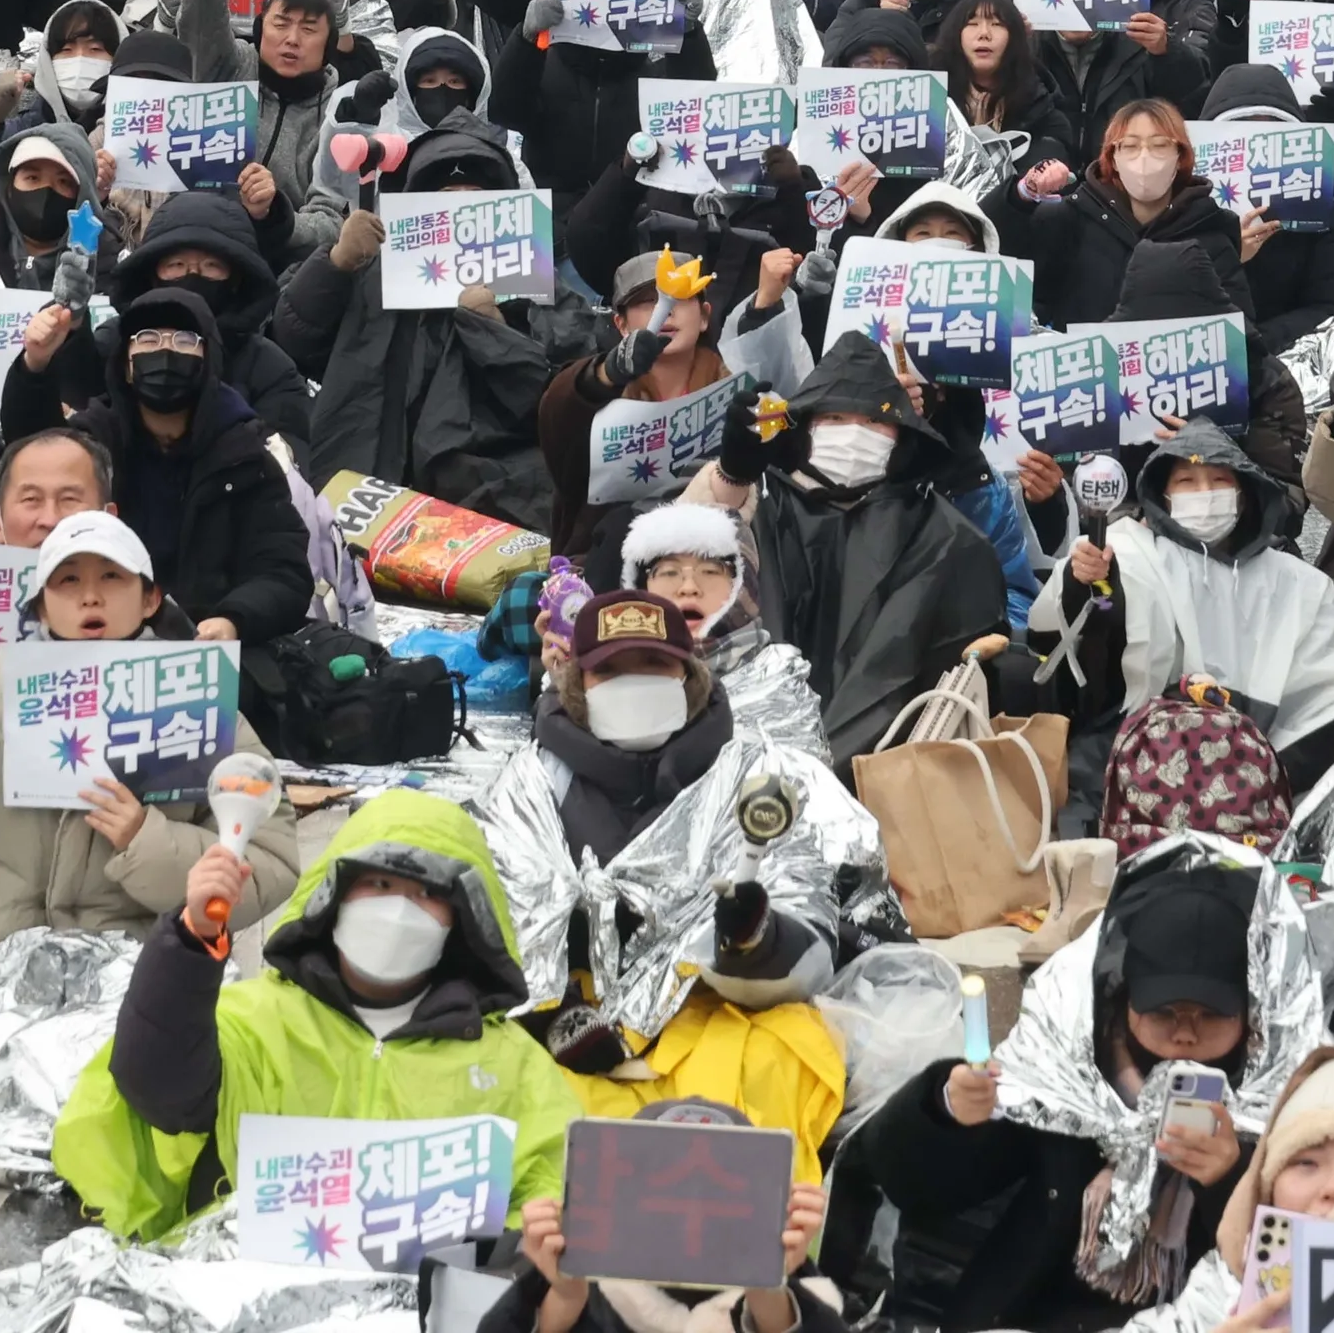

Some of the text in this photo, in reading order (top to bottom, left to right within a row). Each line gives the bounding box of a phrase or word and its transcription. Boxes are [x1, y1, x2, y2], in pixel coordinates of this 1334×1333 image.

[114, 99, 165, 118] 내란수괴
[166, 95, 246, 130] 체포!
[804, 86, 856, 103] 내란동조
[804, 101, 856, 117] 국민의힘
[859, 75, 931, 117] 해체
[112, 115, 164, 137] 윤석열
[861, 117, 930, 154] 하라
[166, 131, 247, 168] 구속!
[389, 210, 451, 235] 내란동조
[455, 194, 534, 246] 해체
[390, 230, 451, 252] 국민의힘
[455, 245, 535, 288] 하라
[845, 264, 909, 285] 내란수괴
[908, 260, 1000, 306] 체포!
[843, 282, 905, 309] 윤석열
[906, 310, 997, 354] 구속!
[1144, 319, 1227, 374] 해체
[1013, 336, 1105, 395] 체포!
[1149, 366, 1230, 419] 하라
[601, 418, 668, 442] 내란수괴
[1018, 383, 1106, 440] 구속!
[601, 438, 667, 465] 윤석열
[17, 666, 101, 697] 내란수괴
[103, 652, 219, 715] 체포!
[17, 692, 99, 727] 윤석열
[106, 713, 217, 772] 구속!
[254, 1148, 353, 1181] 내란수괴
[359, 1121, 493, 1201] 체포!
[254, 1176, 352, 1214] 윤석열
[361, 1189, 484, 1263] 구속!
